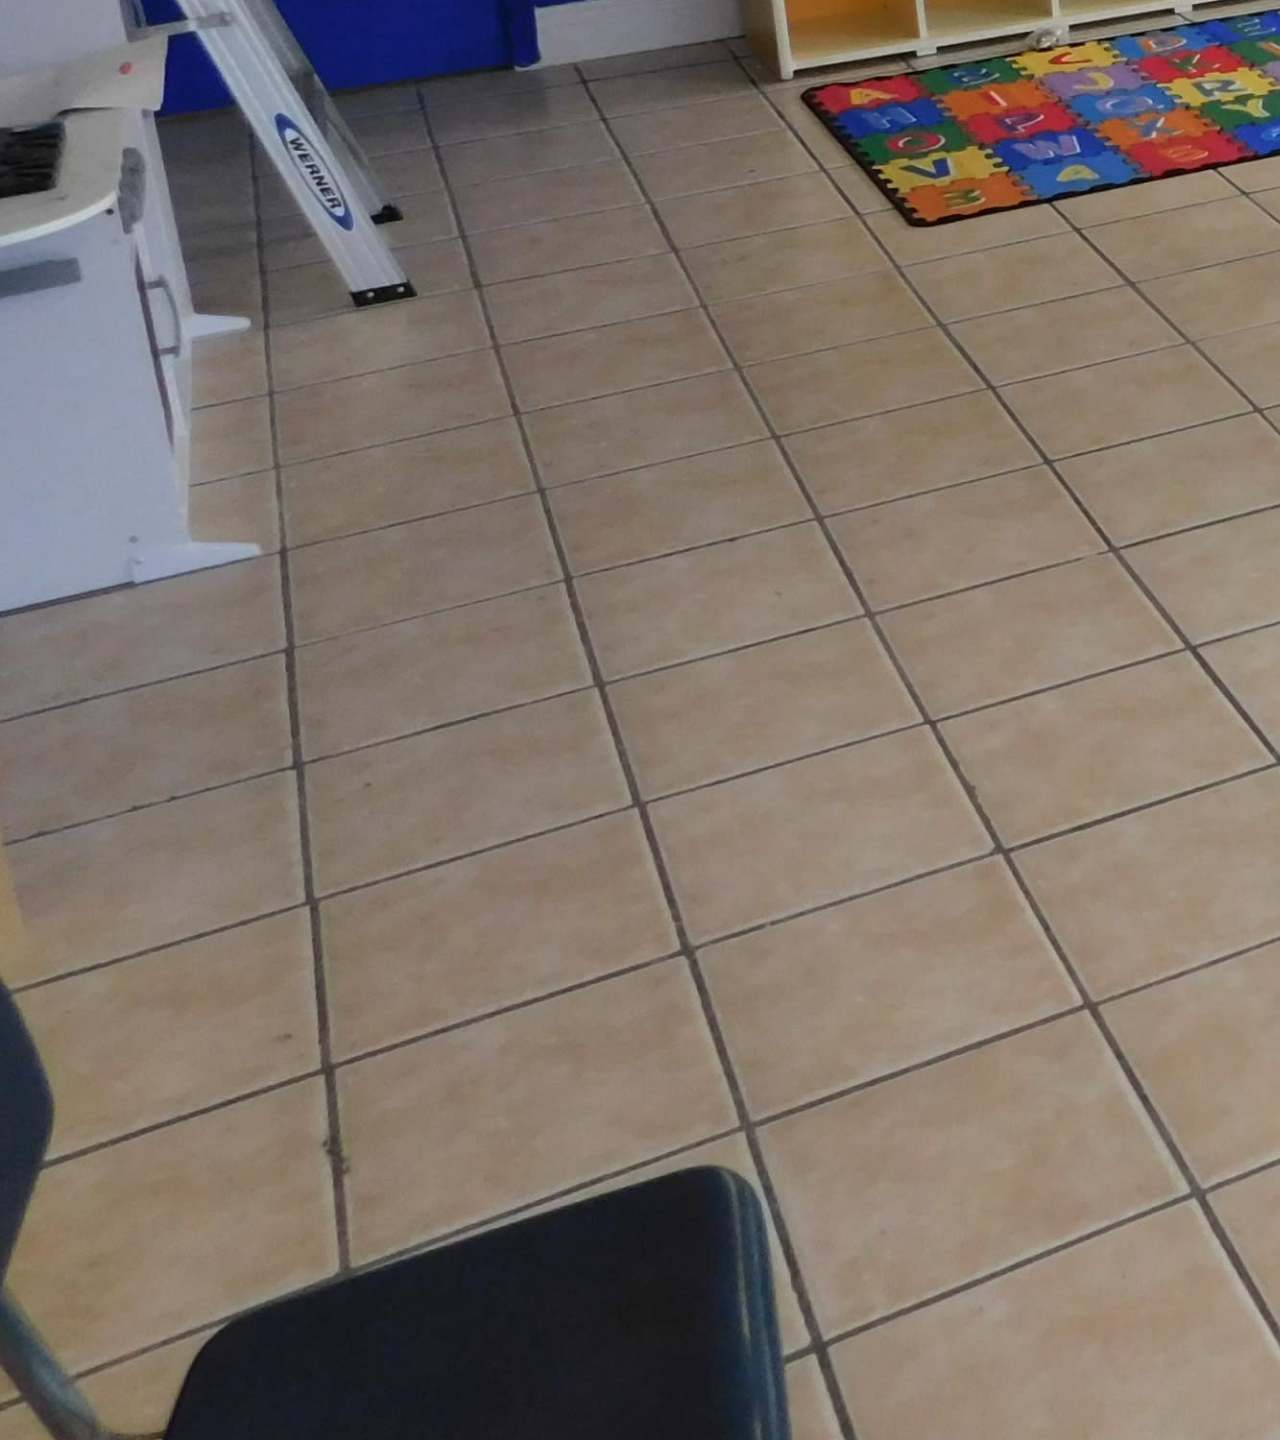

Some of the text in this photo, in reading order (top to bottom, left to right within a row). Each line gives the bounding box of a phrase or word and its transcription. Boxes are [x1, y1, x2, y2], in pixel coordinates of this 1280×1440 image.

[289, 137, 342, 209] WERNER
[900, 157, 952, 179] V
[1221, 98, 1270, 118] Y
